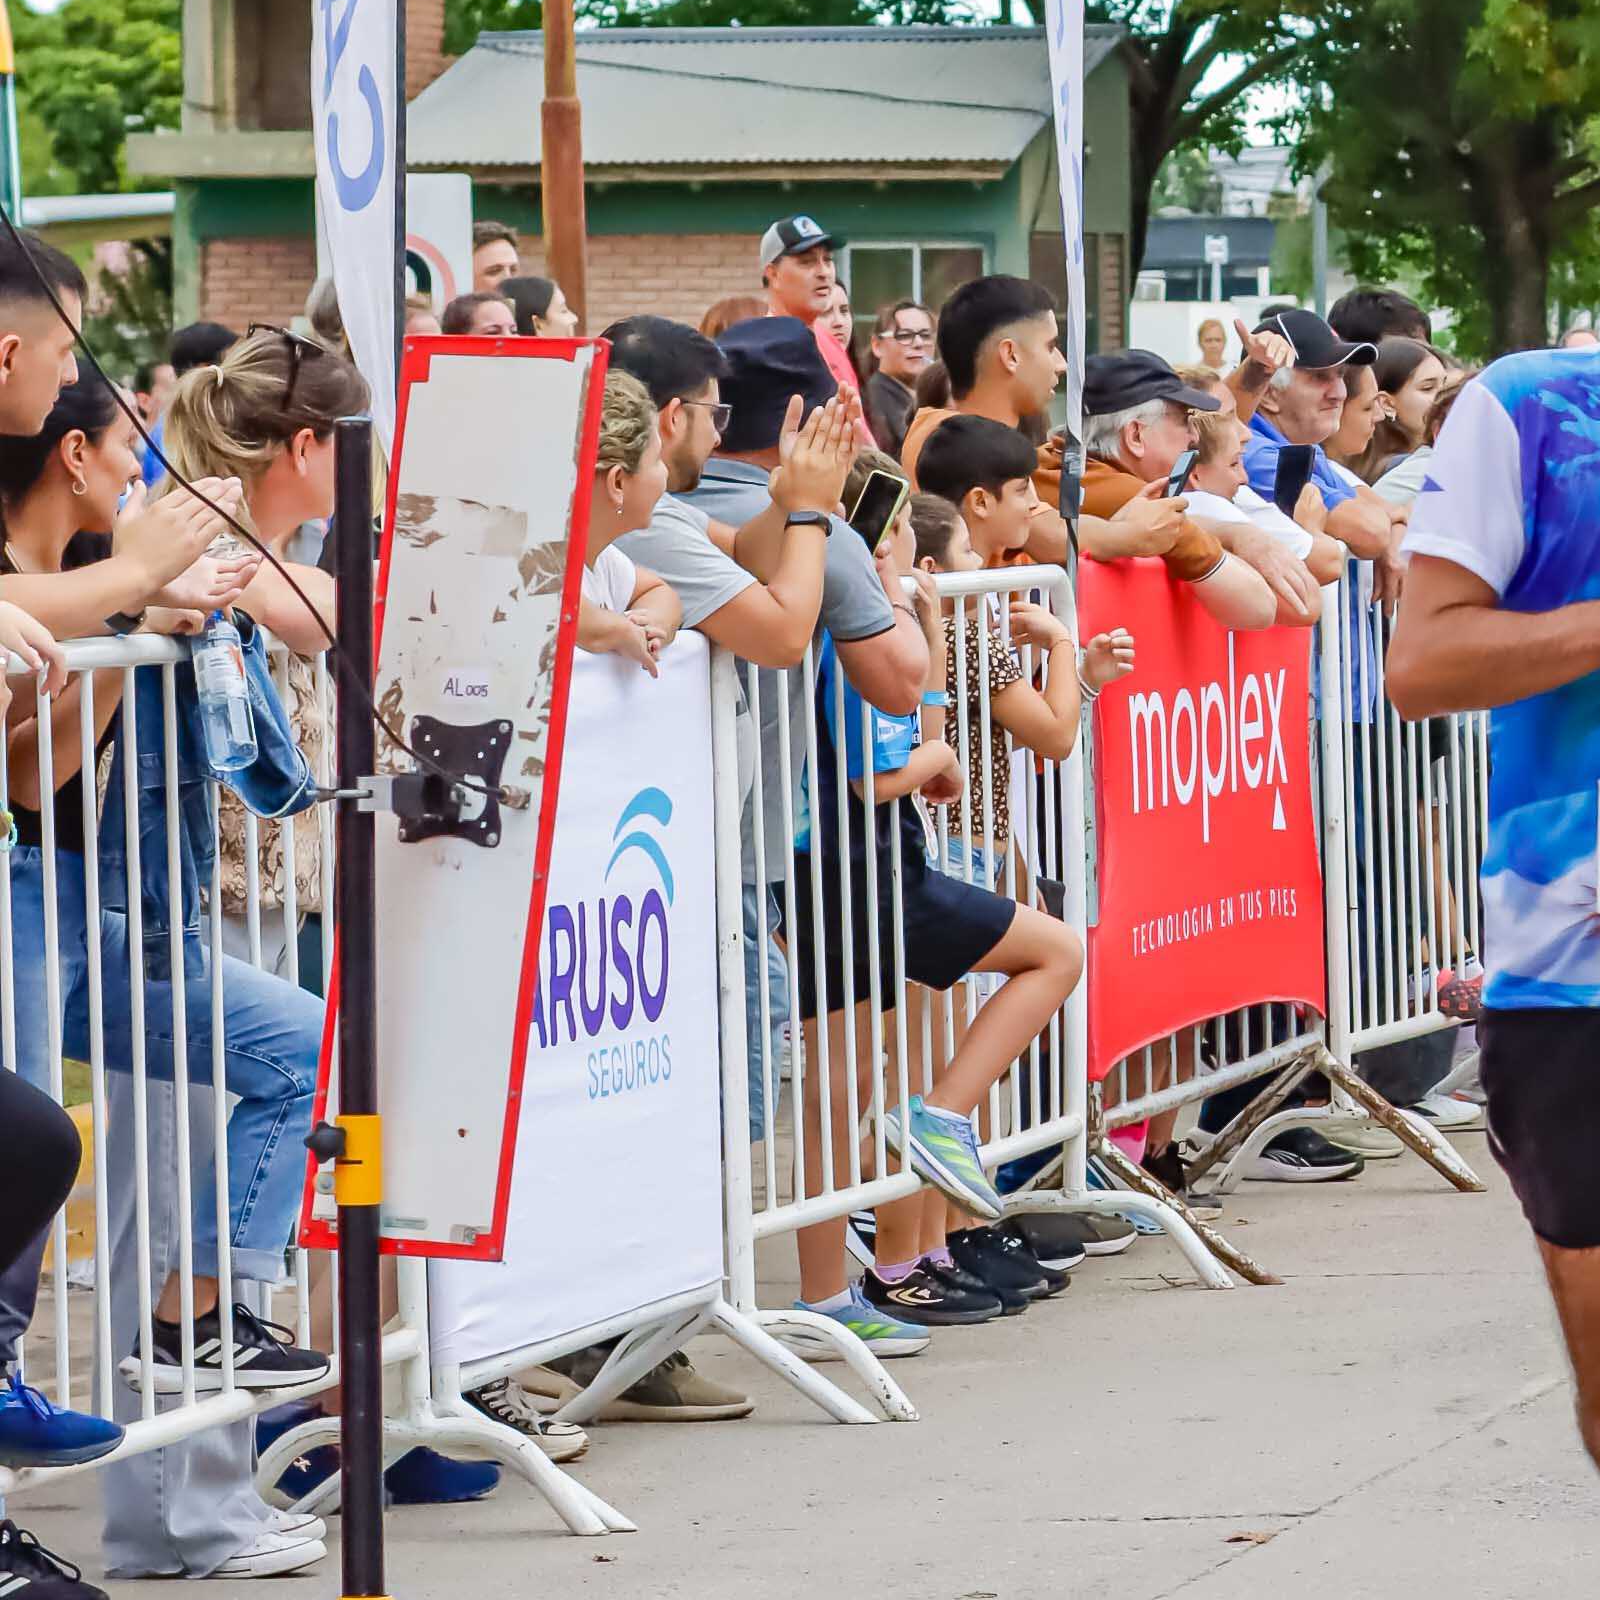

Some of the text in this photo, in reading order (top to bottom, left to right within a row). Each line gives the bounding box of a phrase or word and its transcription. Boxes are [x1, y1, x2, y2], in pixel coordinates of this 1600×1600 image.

[1128, 630, 1289, 844] moplex
[530, 888, 669, 1049] ARUSO
[1132, 888, 1297, 958] TECNOLOGIA EN TUS PIES
[587, 1034, 672, 1100] SEGUROS
